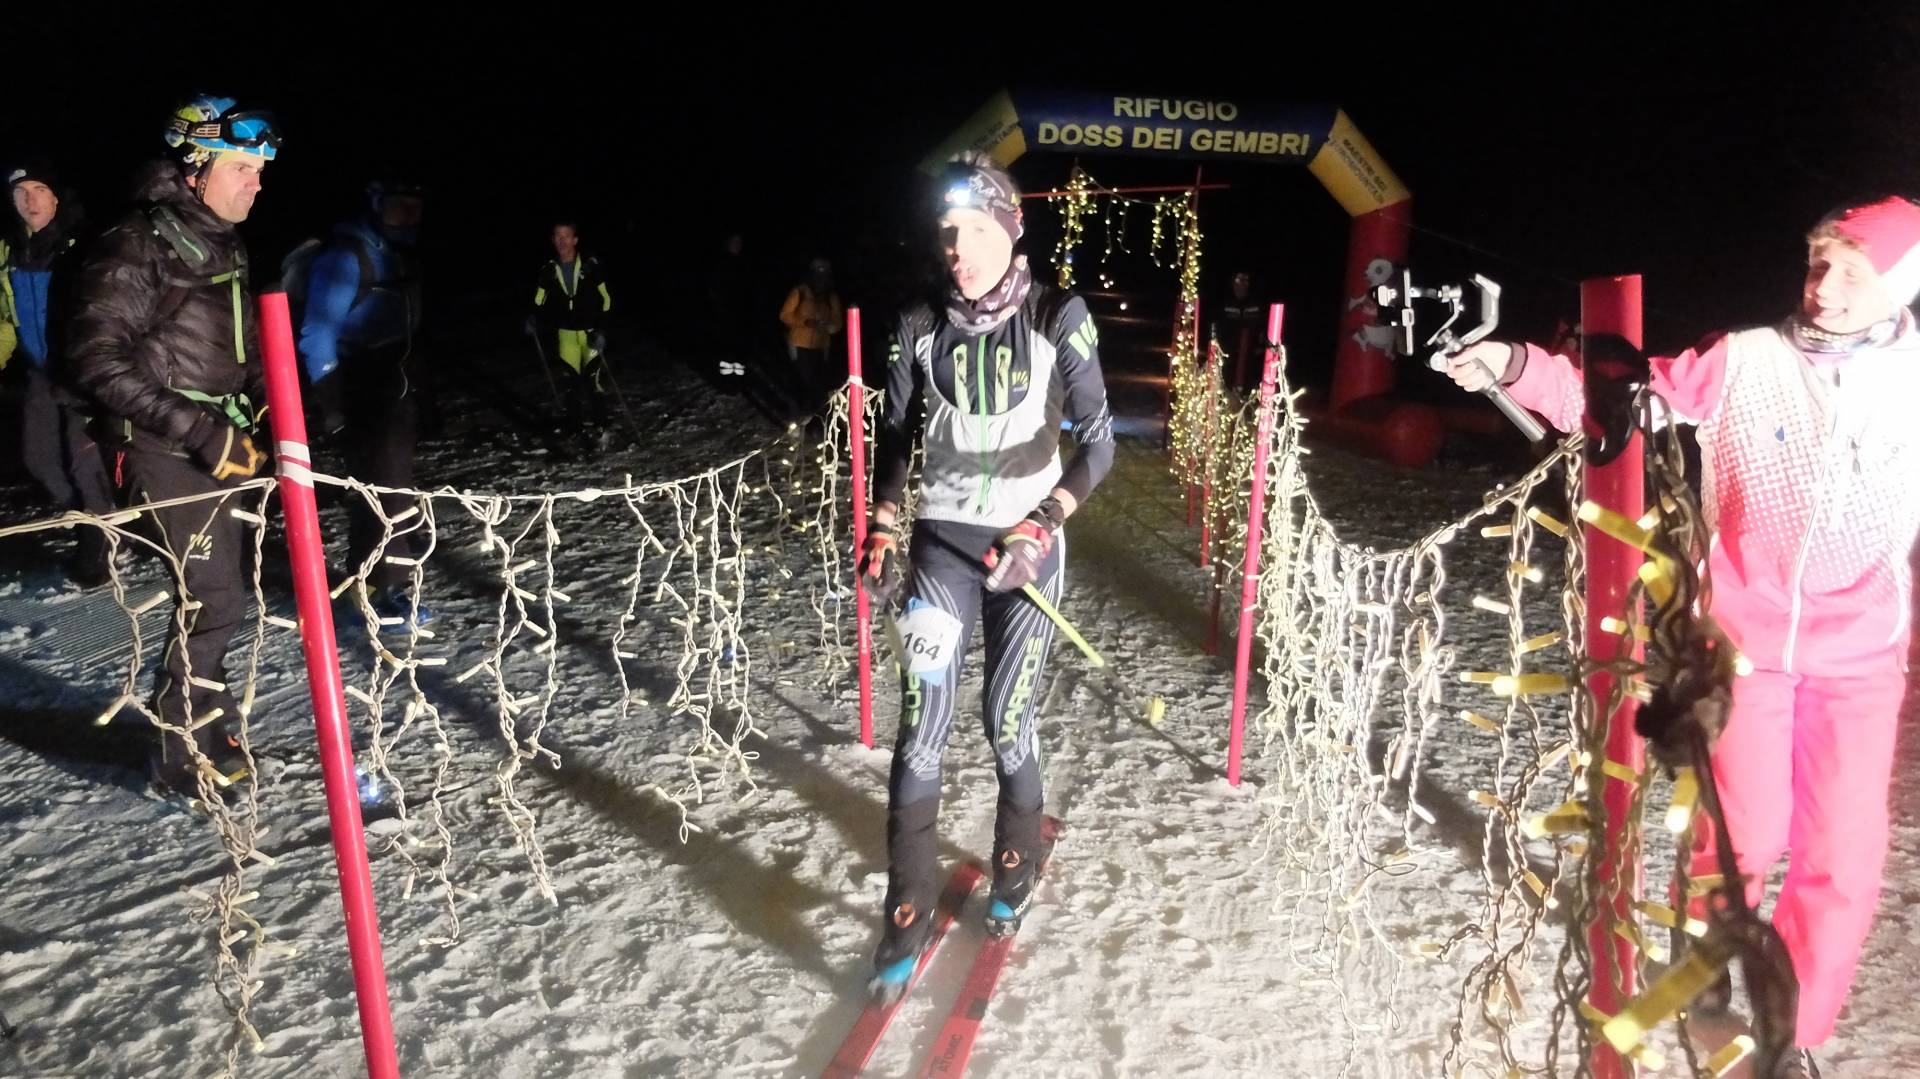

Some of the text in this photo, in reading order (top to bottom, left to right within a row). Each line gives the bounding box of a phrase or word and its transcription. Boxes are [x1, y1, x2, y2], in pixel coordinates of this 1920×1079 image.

[1113, 96, 1238, 122] RIFUGIO
[1037, 122, 1124, 149] DOSS
[1132, 126, 1182, 151] DEI
[1189, 128, 1310, 156] GEMBRI
[903, 632, 940, 661] 164
[998, 637, 1045, 744] KARPOS
[937, 1033, 963, 1072] ATOMIC
